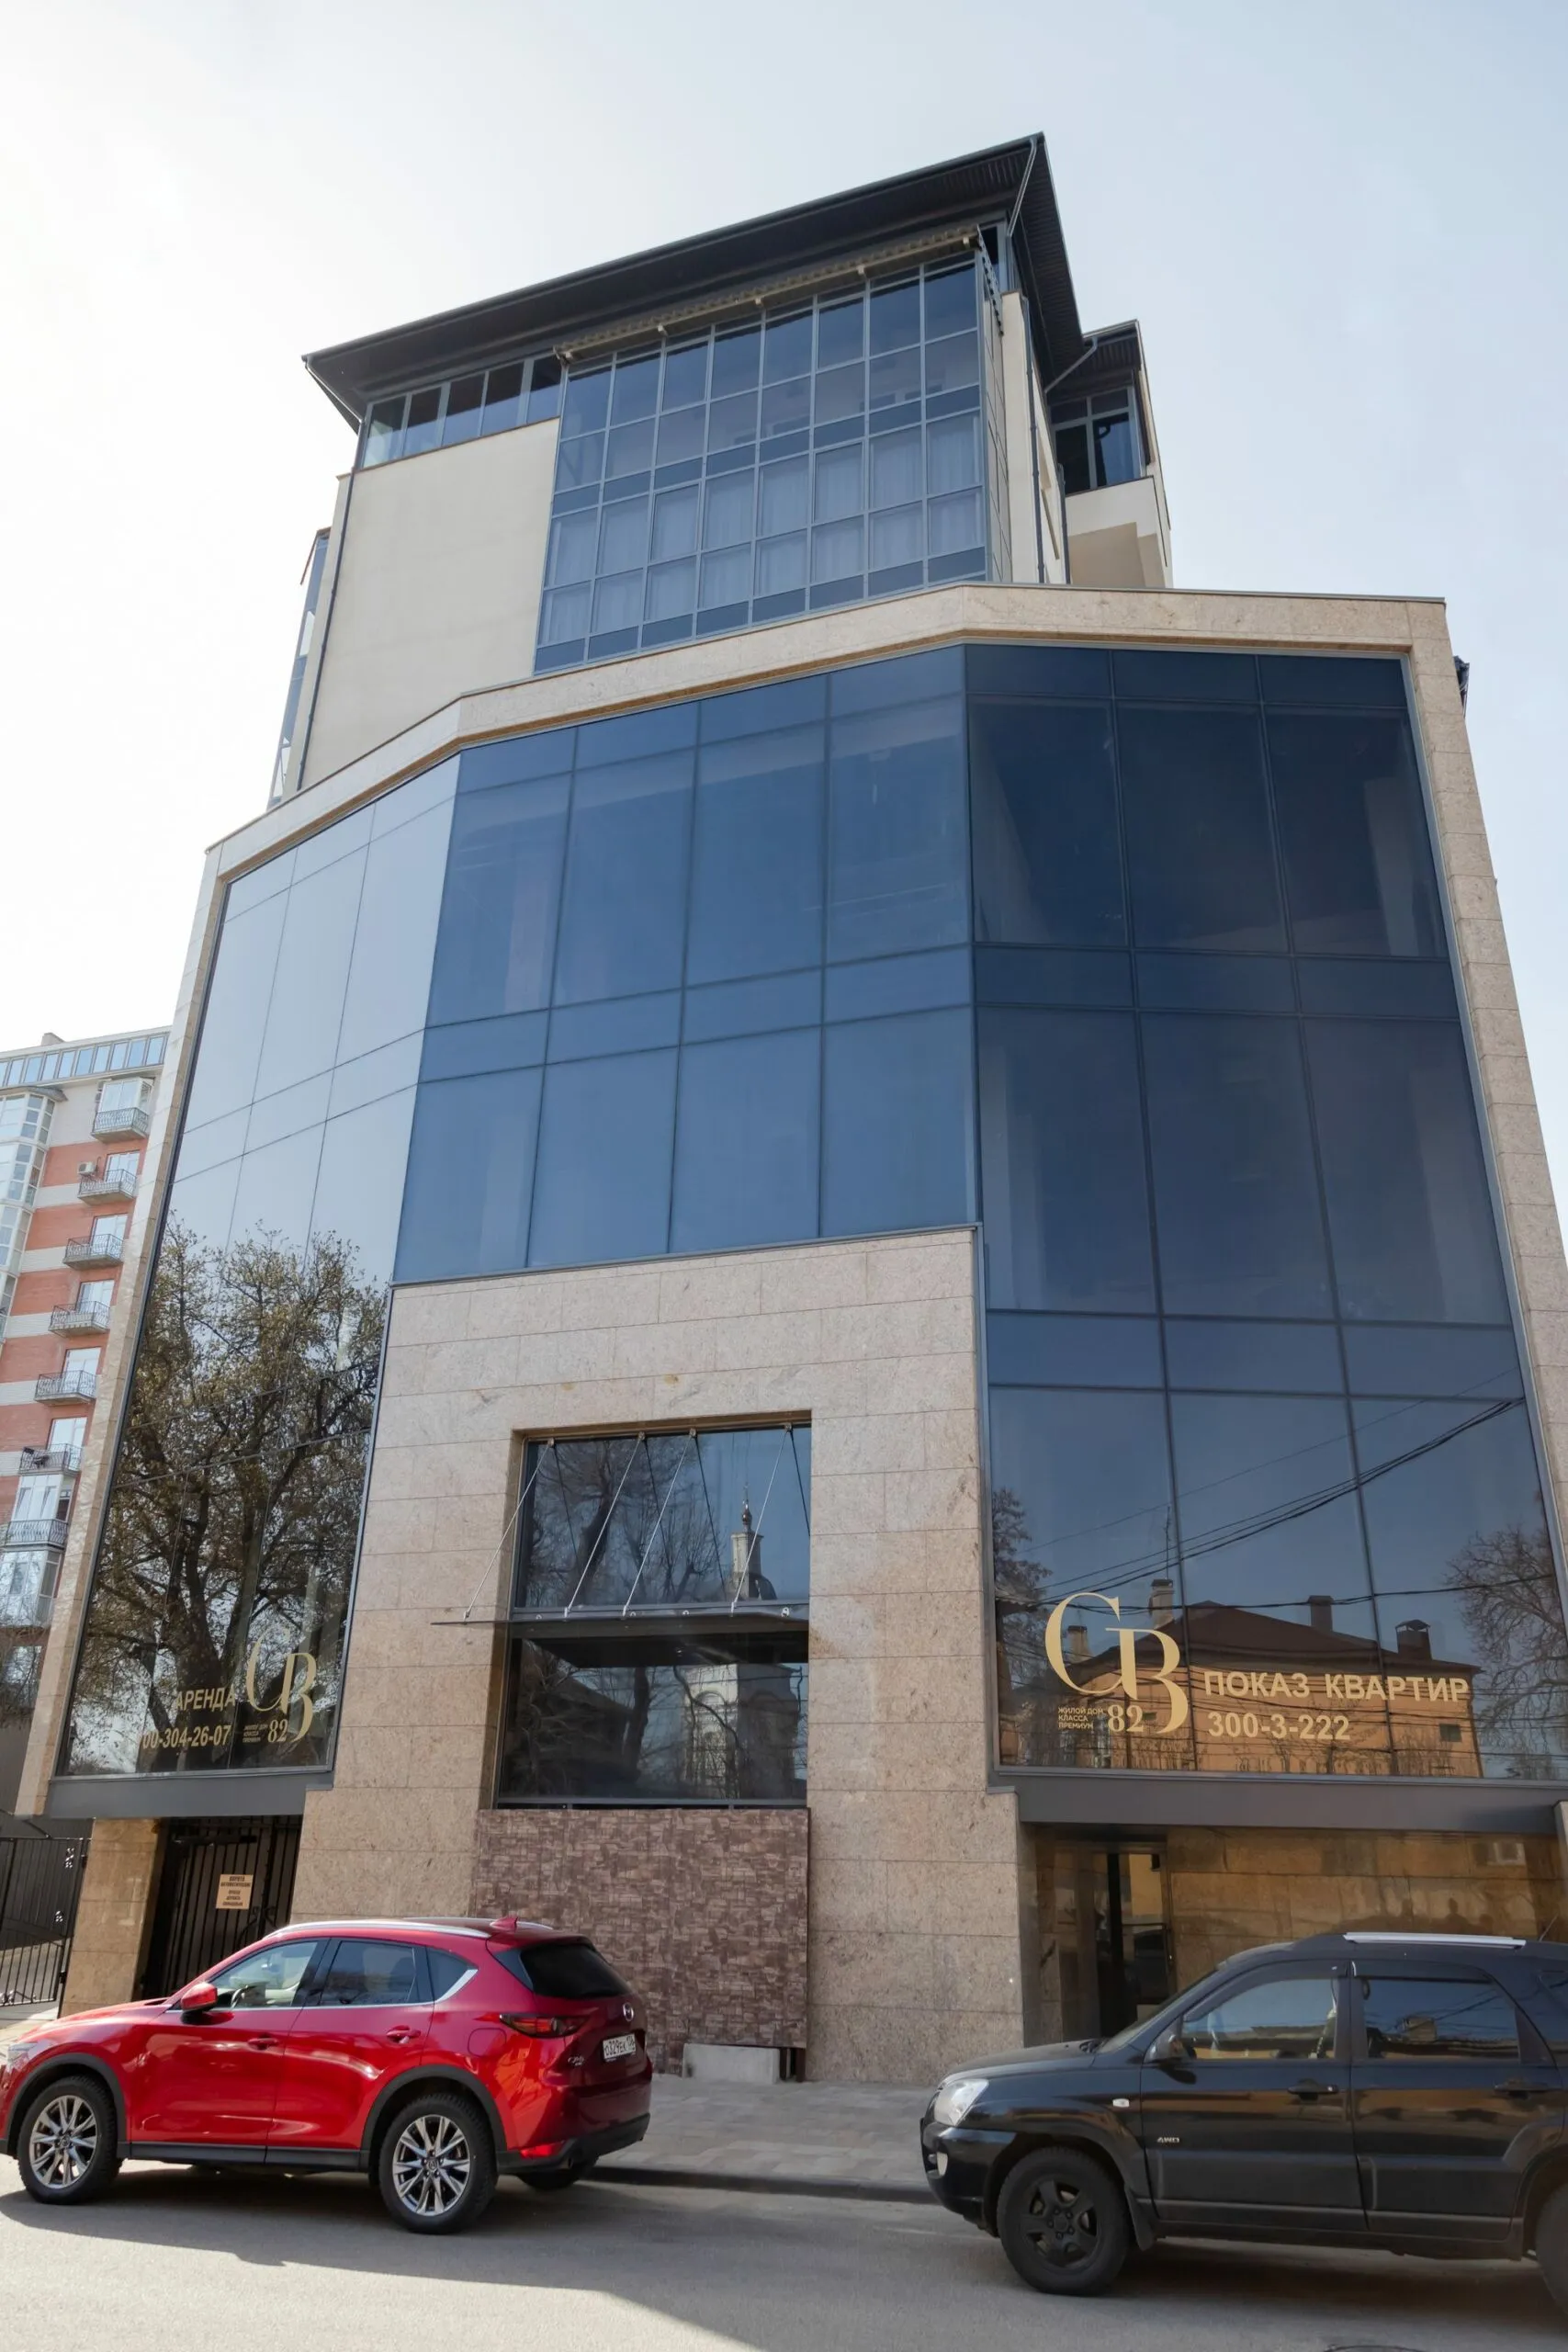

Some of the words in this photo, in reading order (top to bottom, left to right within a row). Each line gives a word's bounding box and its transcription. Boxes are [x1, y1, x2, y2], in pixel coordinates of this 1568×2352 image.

[175, 1683, 236, 1713] АРЕНДА
[1203, 1671, 1310, 1698] ПОКАЗ
[1325, 1673, 1469, 1702] КВАРТИР
[1058, 1706, 1086, 1714] ЖИЛОЙ
[1088, 1708, 1104, 1716] ДОМ
[1107, 1704, 1145, 1732] 82
[139, 1724, 232, 1749] 00-304-26-07
[267, 1719, 288, 1743] 82
[1208, 1713, 1351, 1740] 300-3-222
